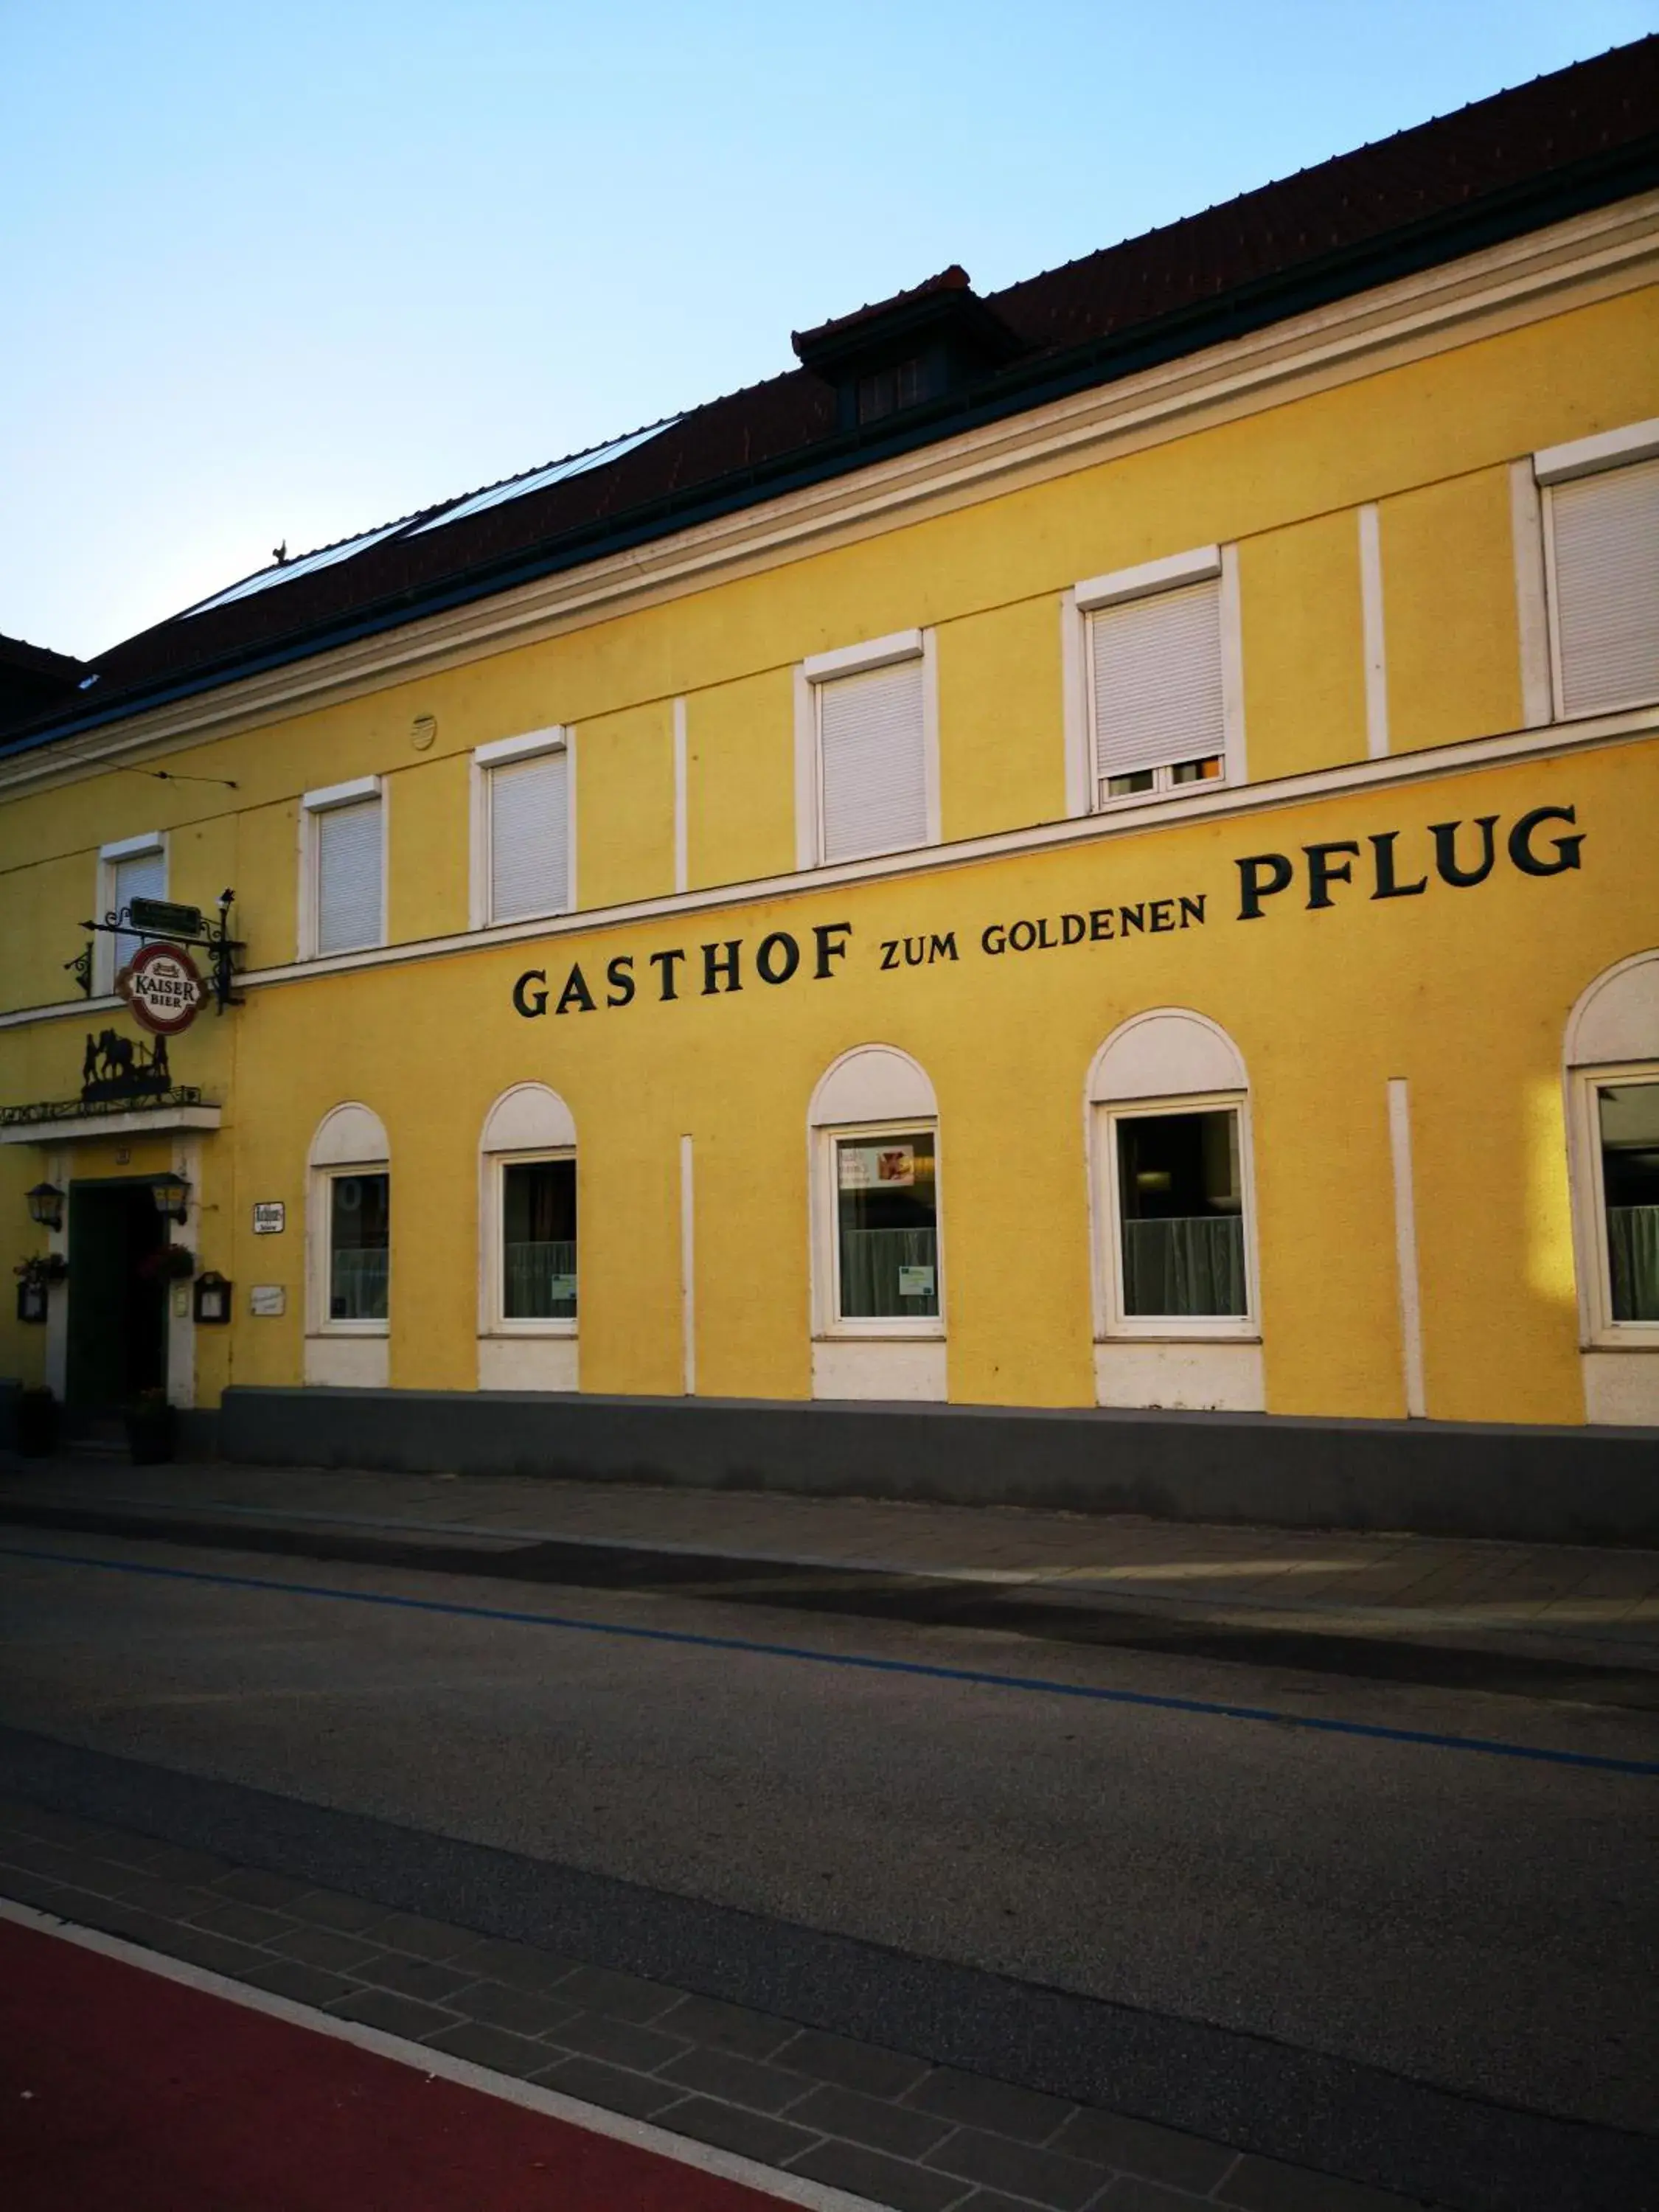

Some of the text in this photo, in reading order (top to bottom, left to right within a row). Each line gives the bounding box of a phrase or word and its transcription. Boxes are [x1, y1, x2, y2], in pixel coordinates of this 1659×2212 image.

[512, 804, 1587, 1018] GASTHOF ZUM GOLDENEN PFLUG
[136, 975, 195, 1001] KAISER
[150, 994, 182, 1008] BIER
